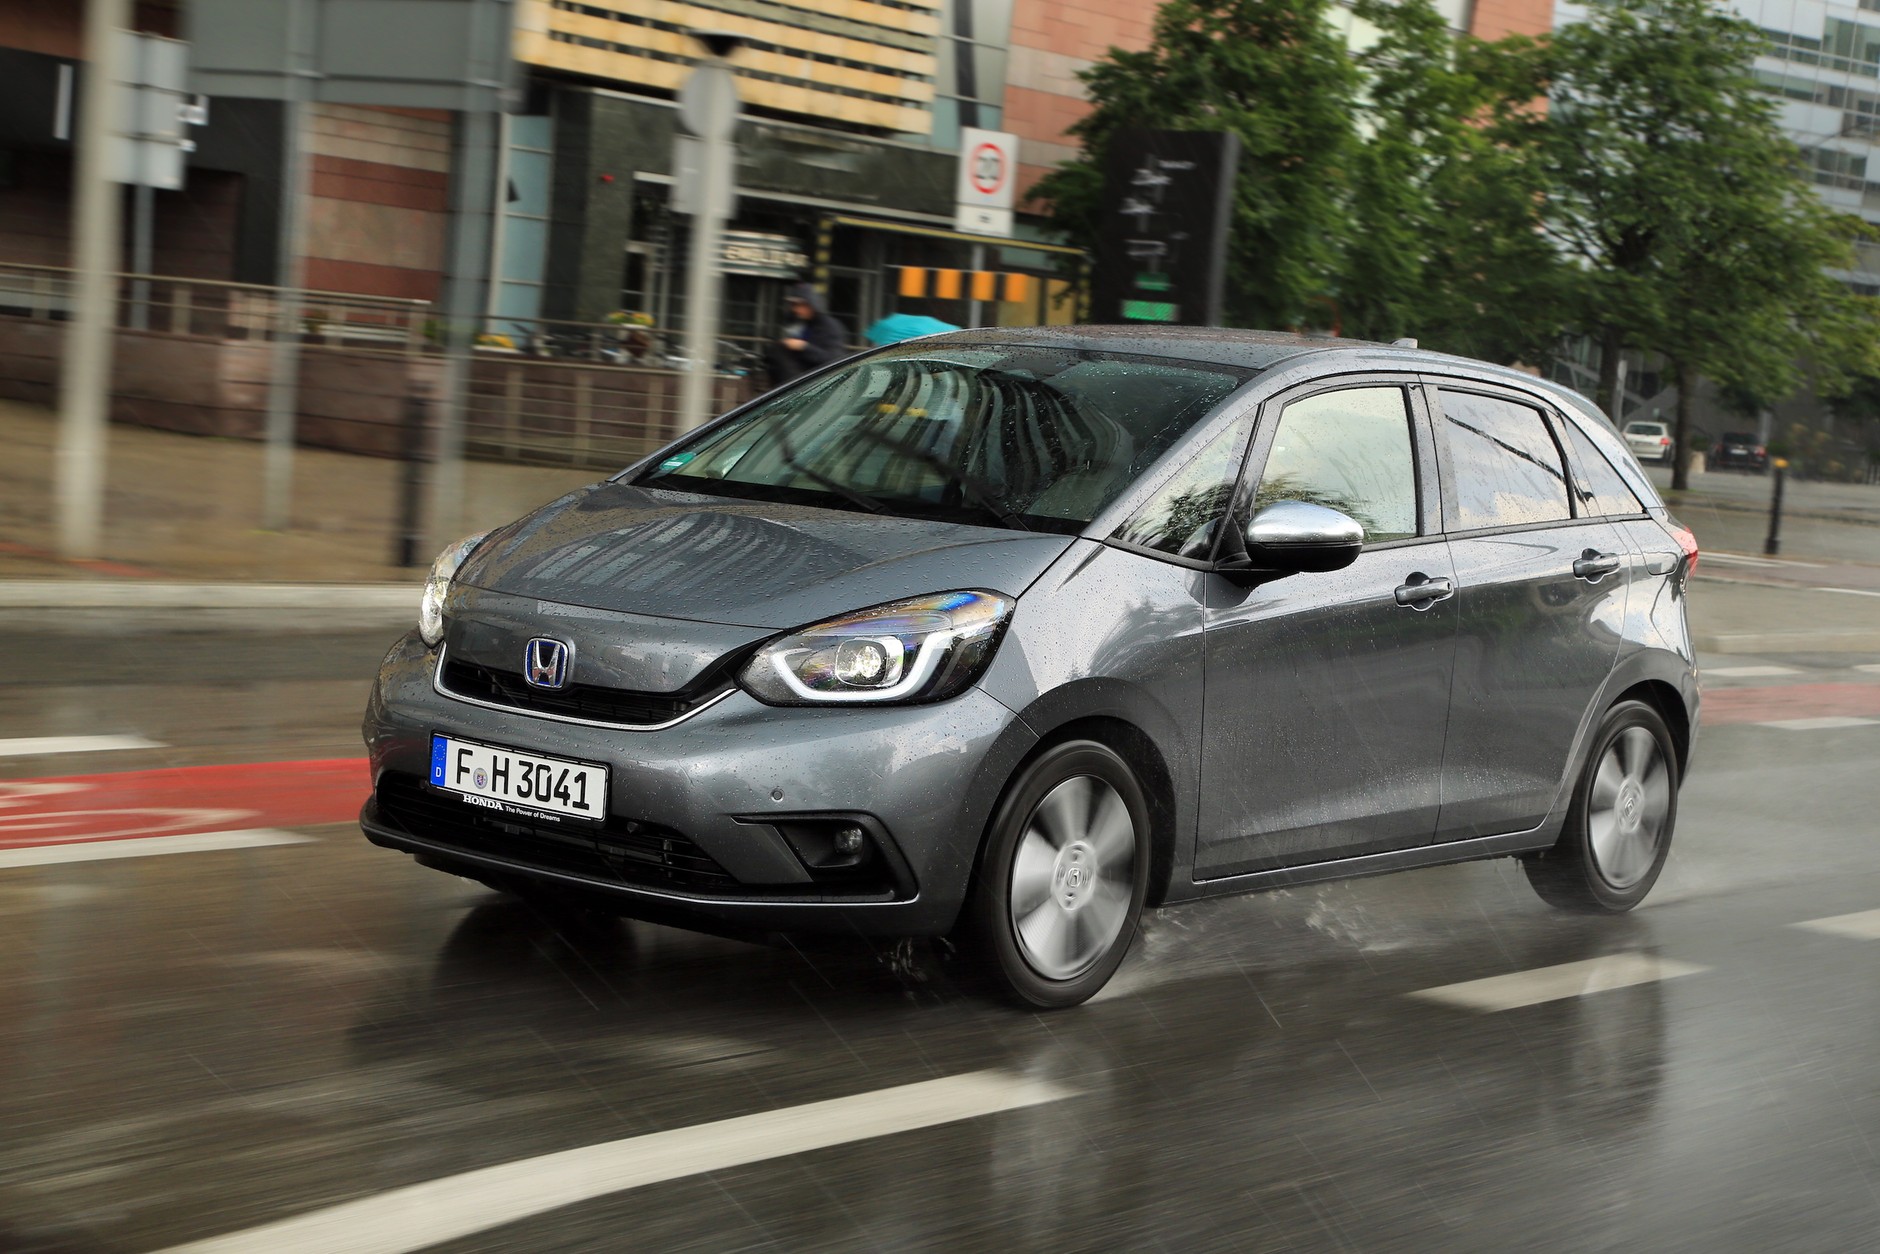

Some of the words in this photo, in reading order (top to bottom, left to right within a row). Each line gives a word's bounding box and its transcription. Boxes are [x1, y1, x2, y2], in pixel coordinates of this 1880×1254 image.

[435, 766, 442, 778] D
[456, 747, 474, 784] F
[491, 755, 510, 795] H
[516, 760, 590, 811] 3041
[462, 794, 504, 811] HONDA
[505, 805, 515, 814] The
[516, 808, 532, 817] Power
[539, 813, 561, 822] Dreams
